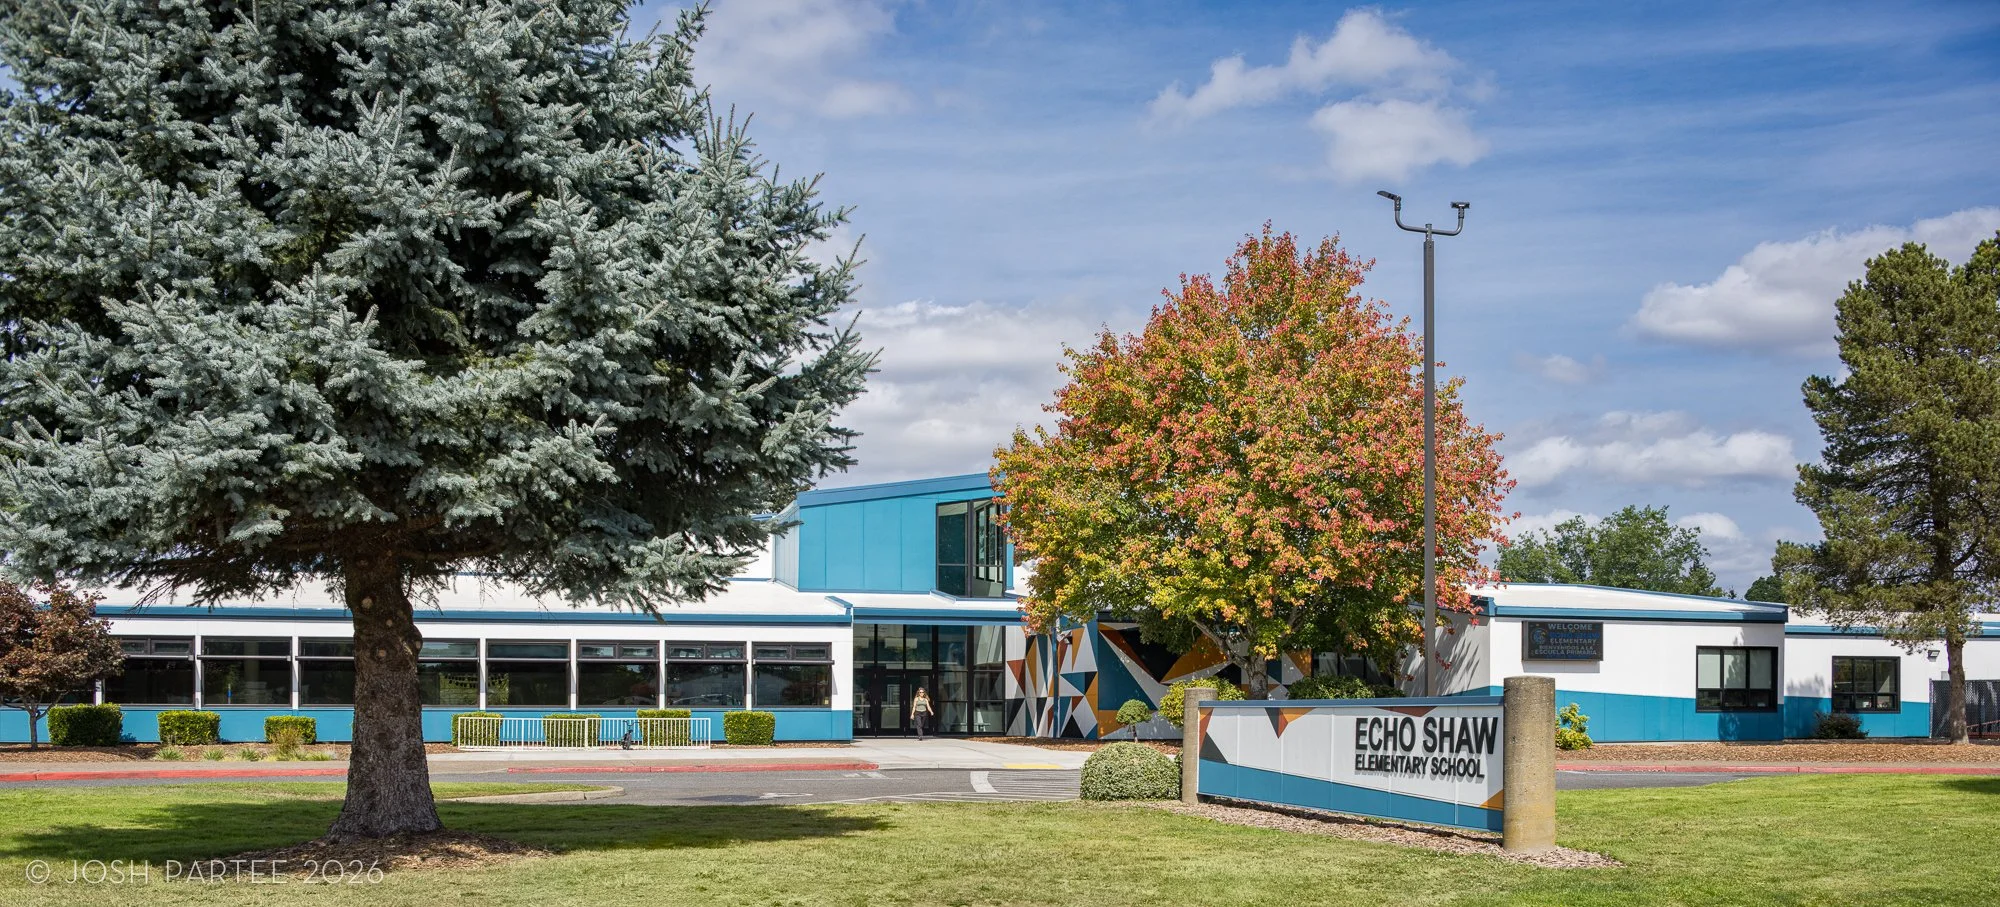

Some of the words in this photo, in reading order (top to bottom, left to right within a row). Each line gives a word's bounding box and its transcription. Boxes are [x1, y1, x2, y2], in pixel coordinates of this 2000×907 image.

[1355, 716, 1416, 752] ECHO
[1422, 717, 1499, 755] SHAW
[1355, 754, 1429, 774] ELEMENTARY
[1430, 756, 1485, 778] SCHOOL
